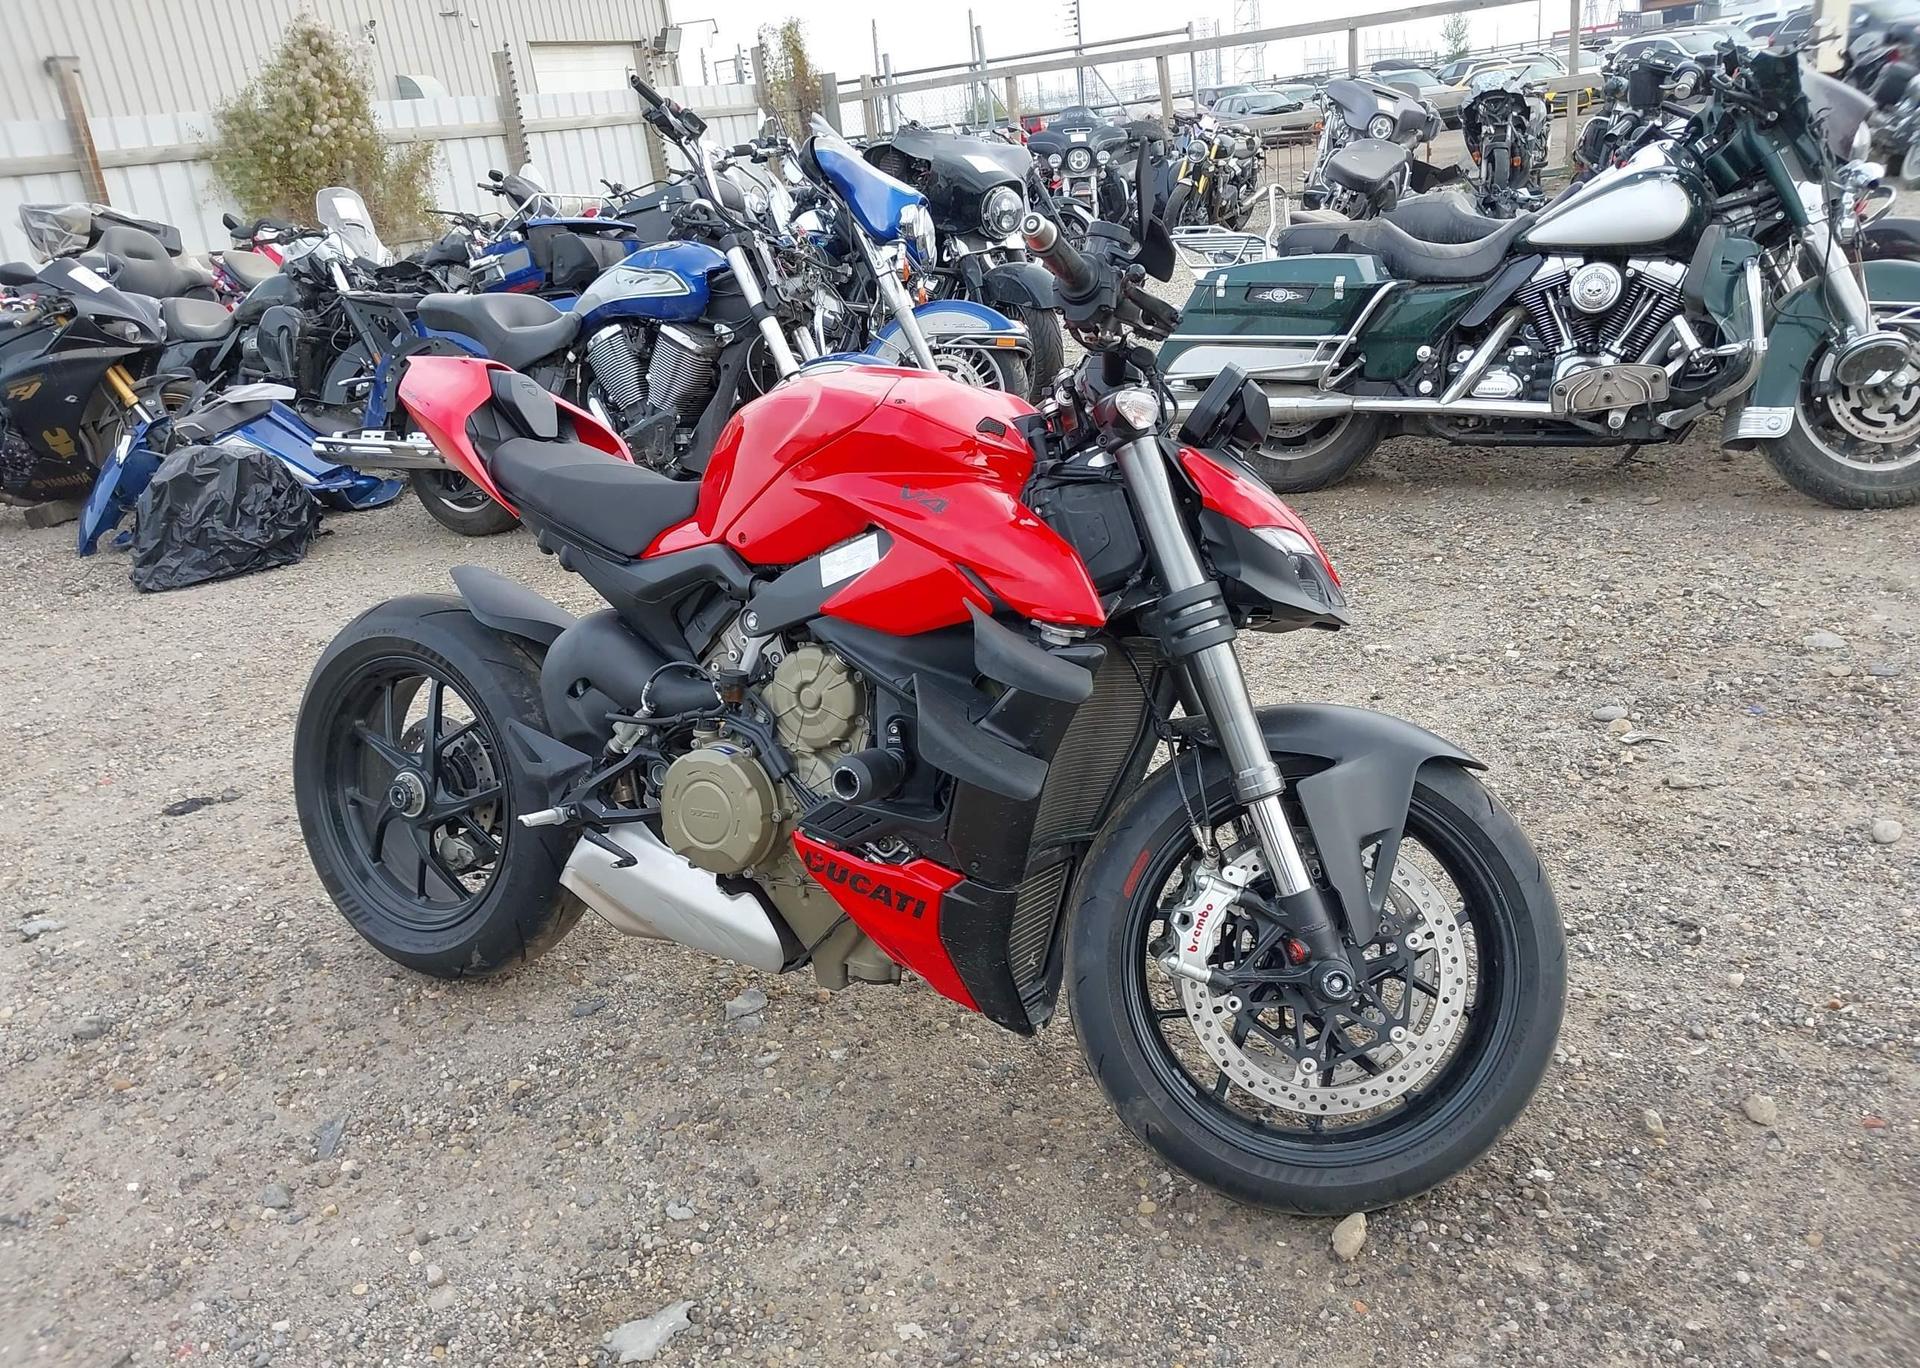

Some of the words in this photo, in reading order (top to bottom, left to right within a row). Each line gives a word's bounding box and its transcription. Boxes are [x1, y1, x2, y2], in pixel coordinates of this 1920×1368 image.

[901, 484, 947, 514] V4
[804, 849, 927, 919] DUCATI
[1187, 903, 1213, 952] brembo
